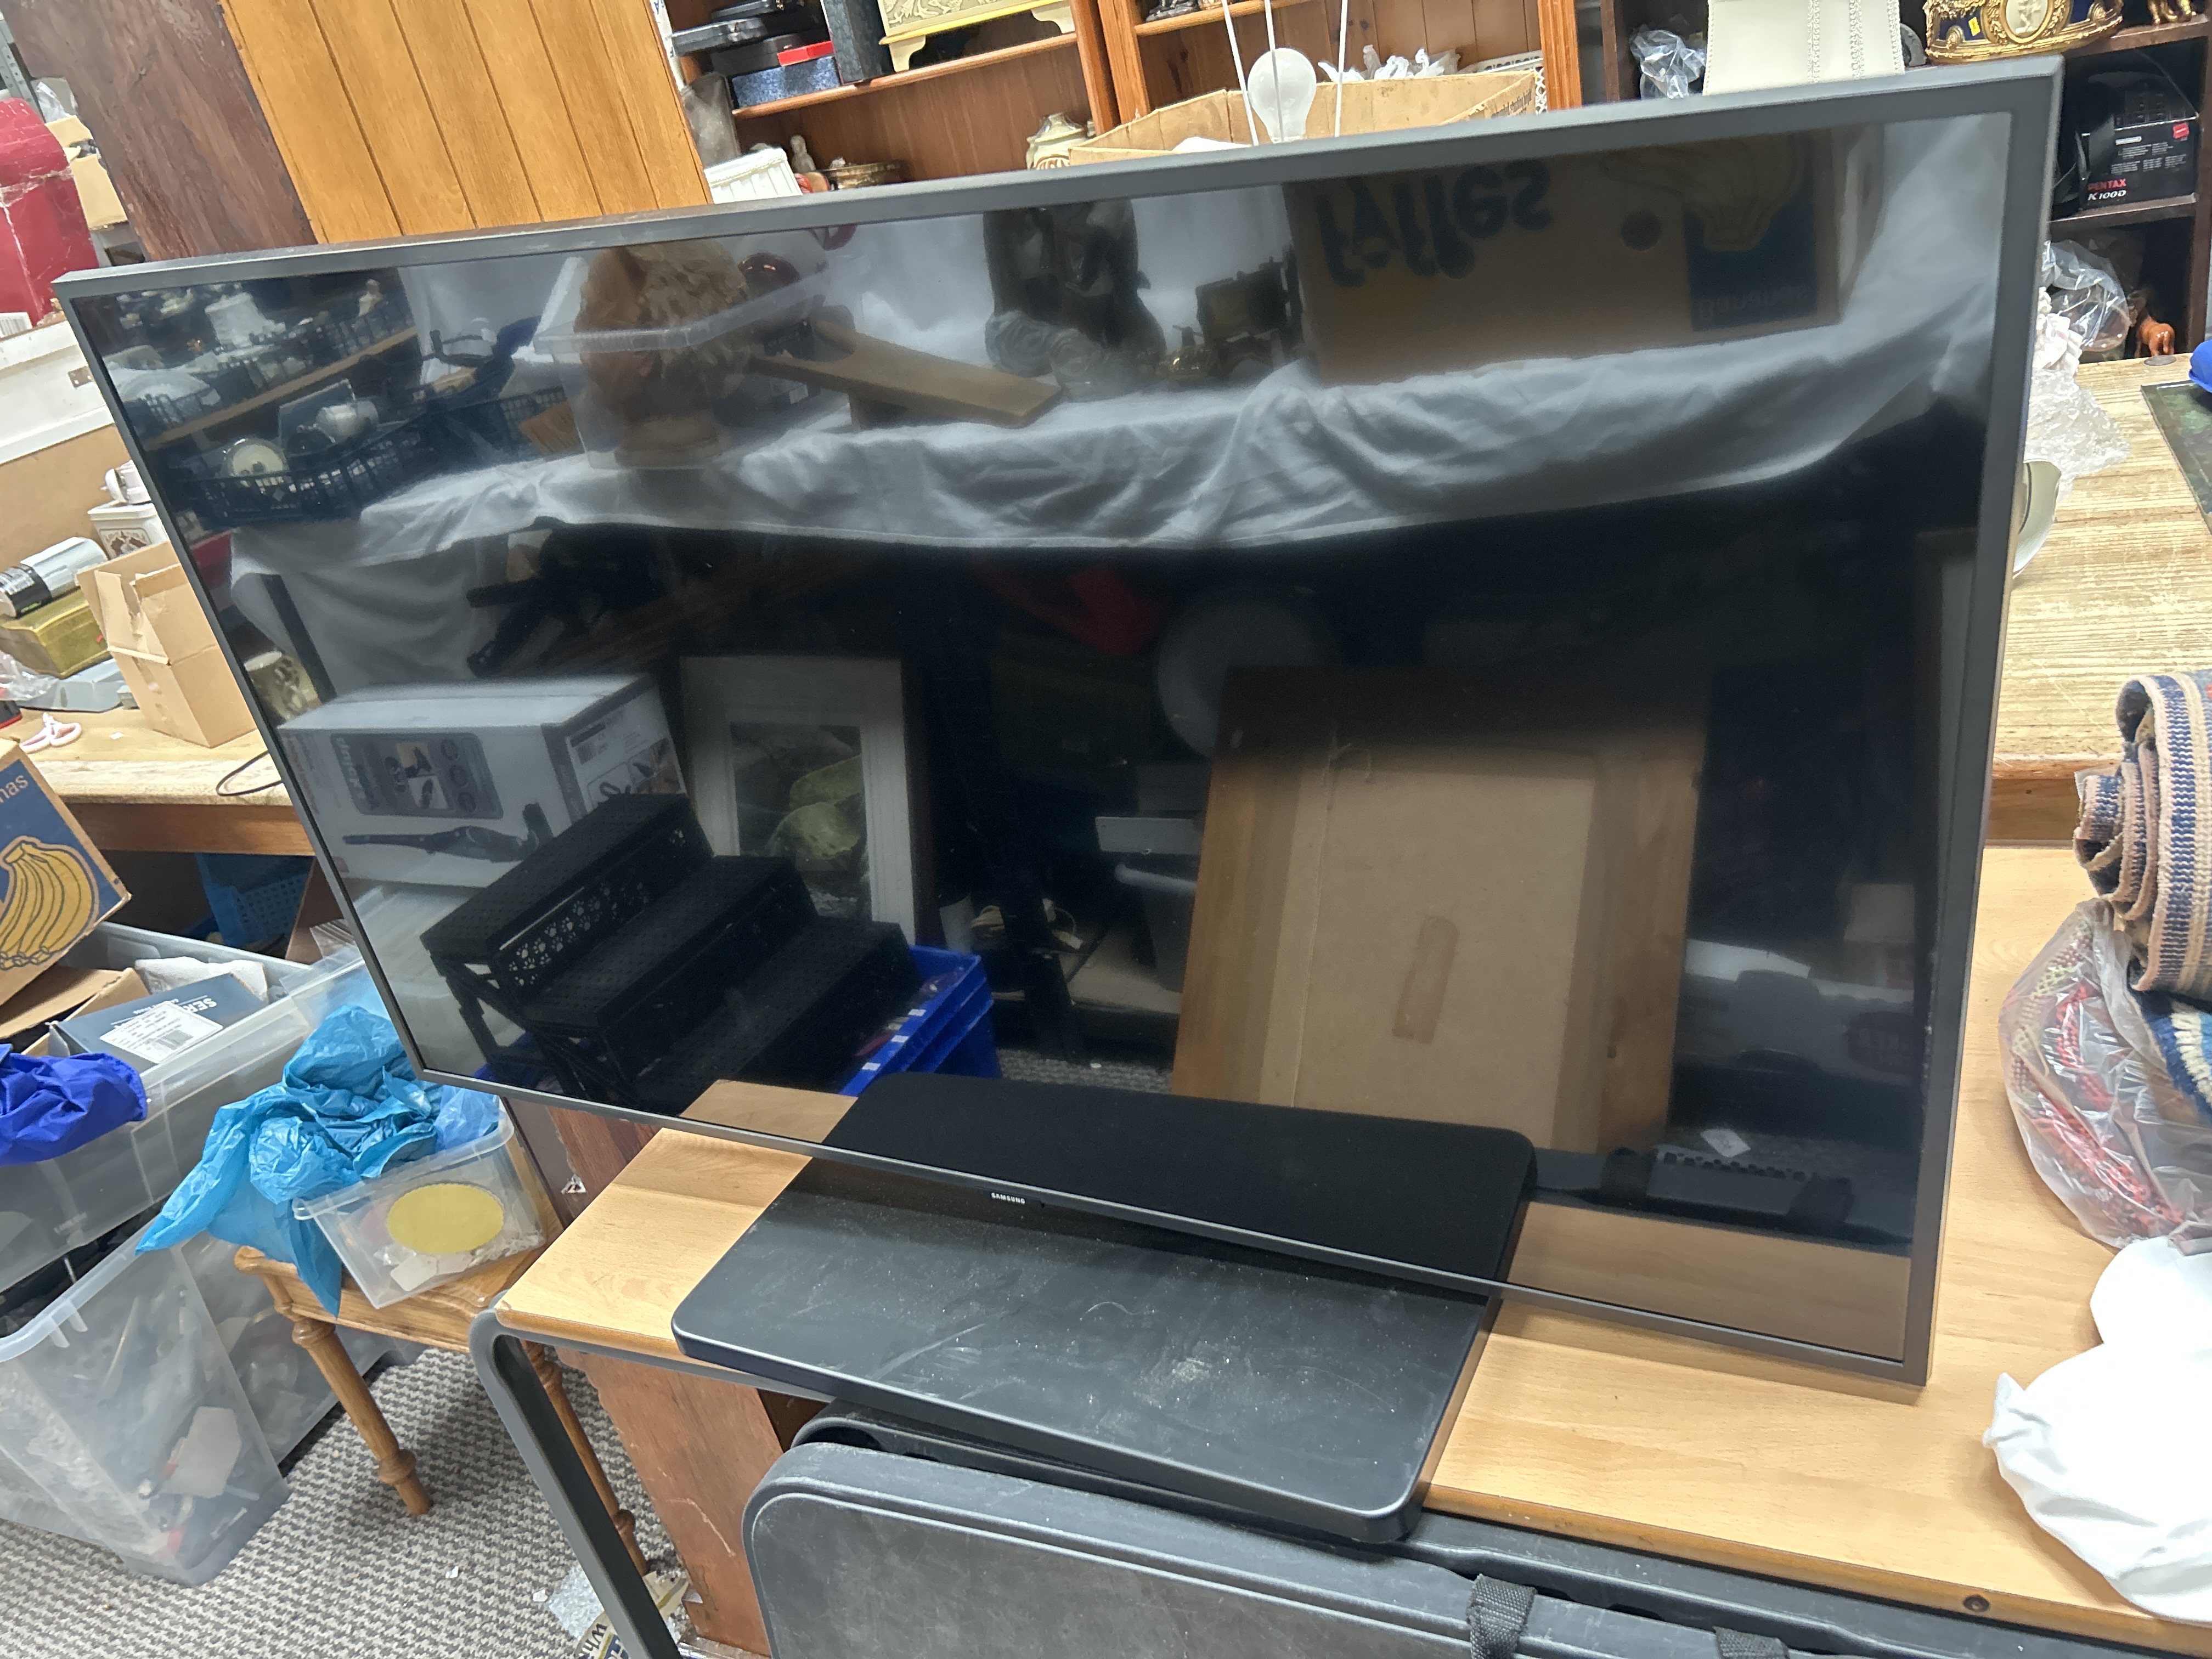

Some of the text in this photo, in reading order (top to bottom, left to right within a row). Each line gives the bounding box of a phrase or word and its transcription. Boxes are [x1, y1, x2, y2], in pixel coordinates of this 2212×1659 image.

[2087, 179, 2126, 190] PENTAX
[2087, 190, 2127, 200] K100D
[991, 1192, 1025, 1204] SAMSUNG
